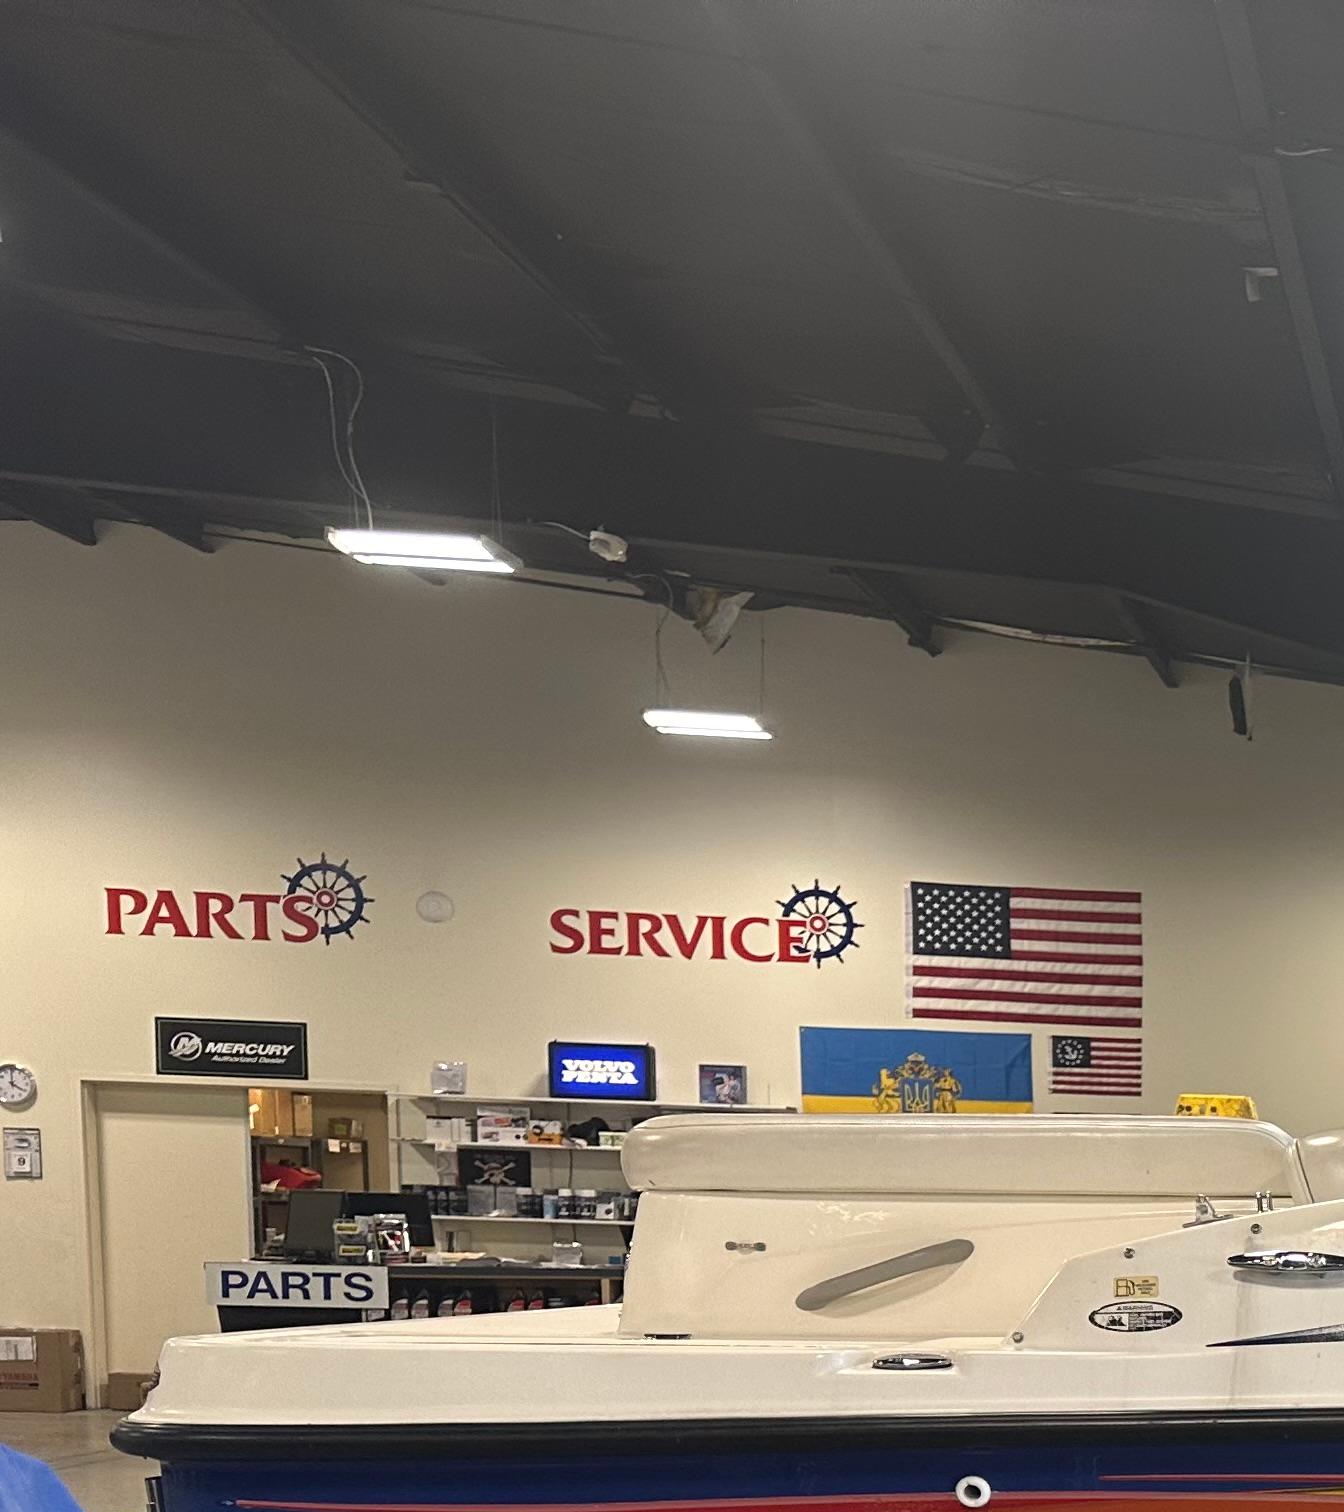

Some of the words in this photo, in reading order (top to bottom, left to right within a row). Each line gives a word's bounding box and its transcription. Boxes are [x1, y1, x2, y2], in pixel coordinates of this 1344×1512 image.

[104, 887, 320, 943] PARTS
[549, 908, 812, 963] SERVICE
[205, 1042, 295, 1057] MERCURY
[562, 1059, 635, 1072] VOLVO
[561, 1070, 639, 1085] PENTA
[220, 1270, 374, 1302] PARTS
